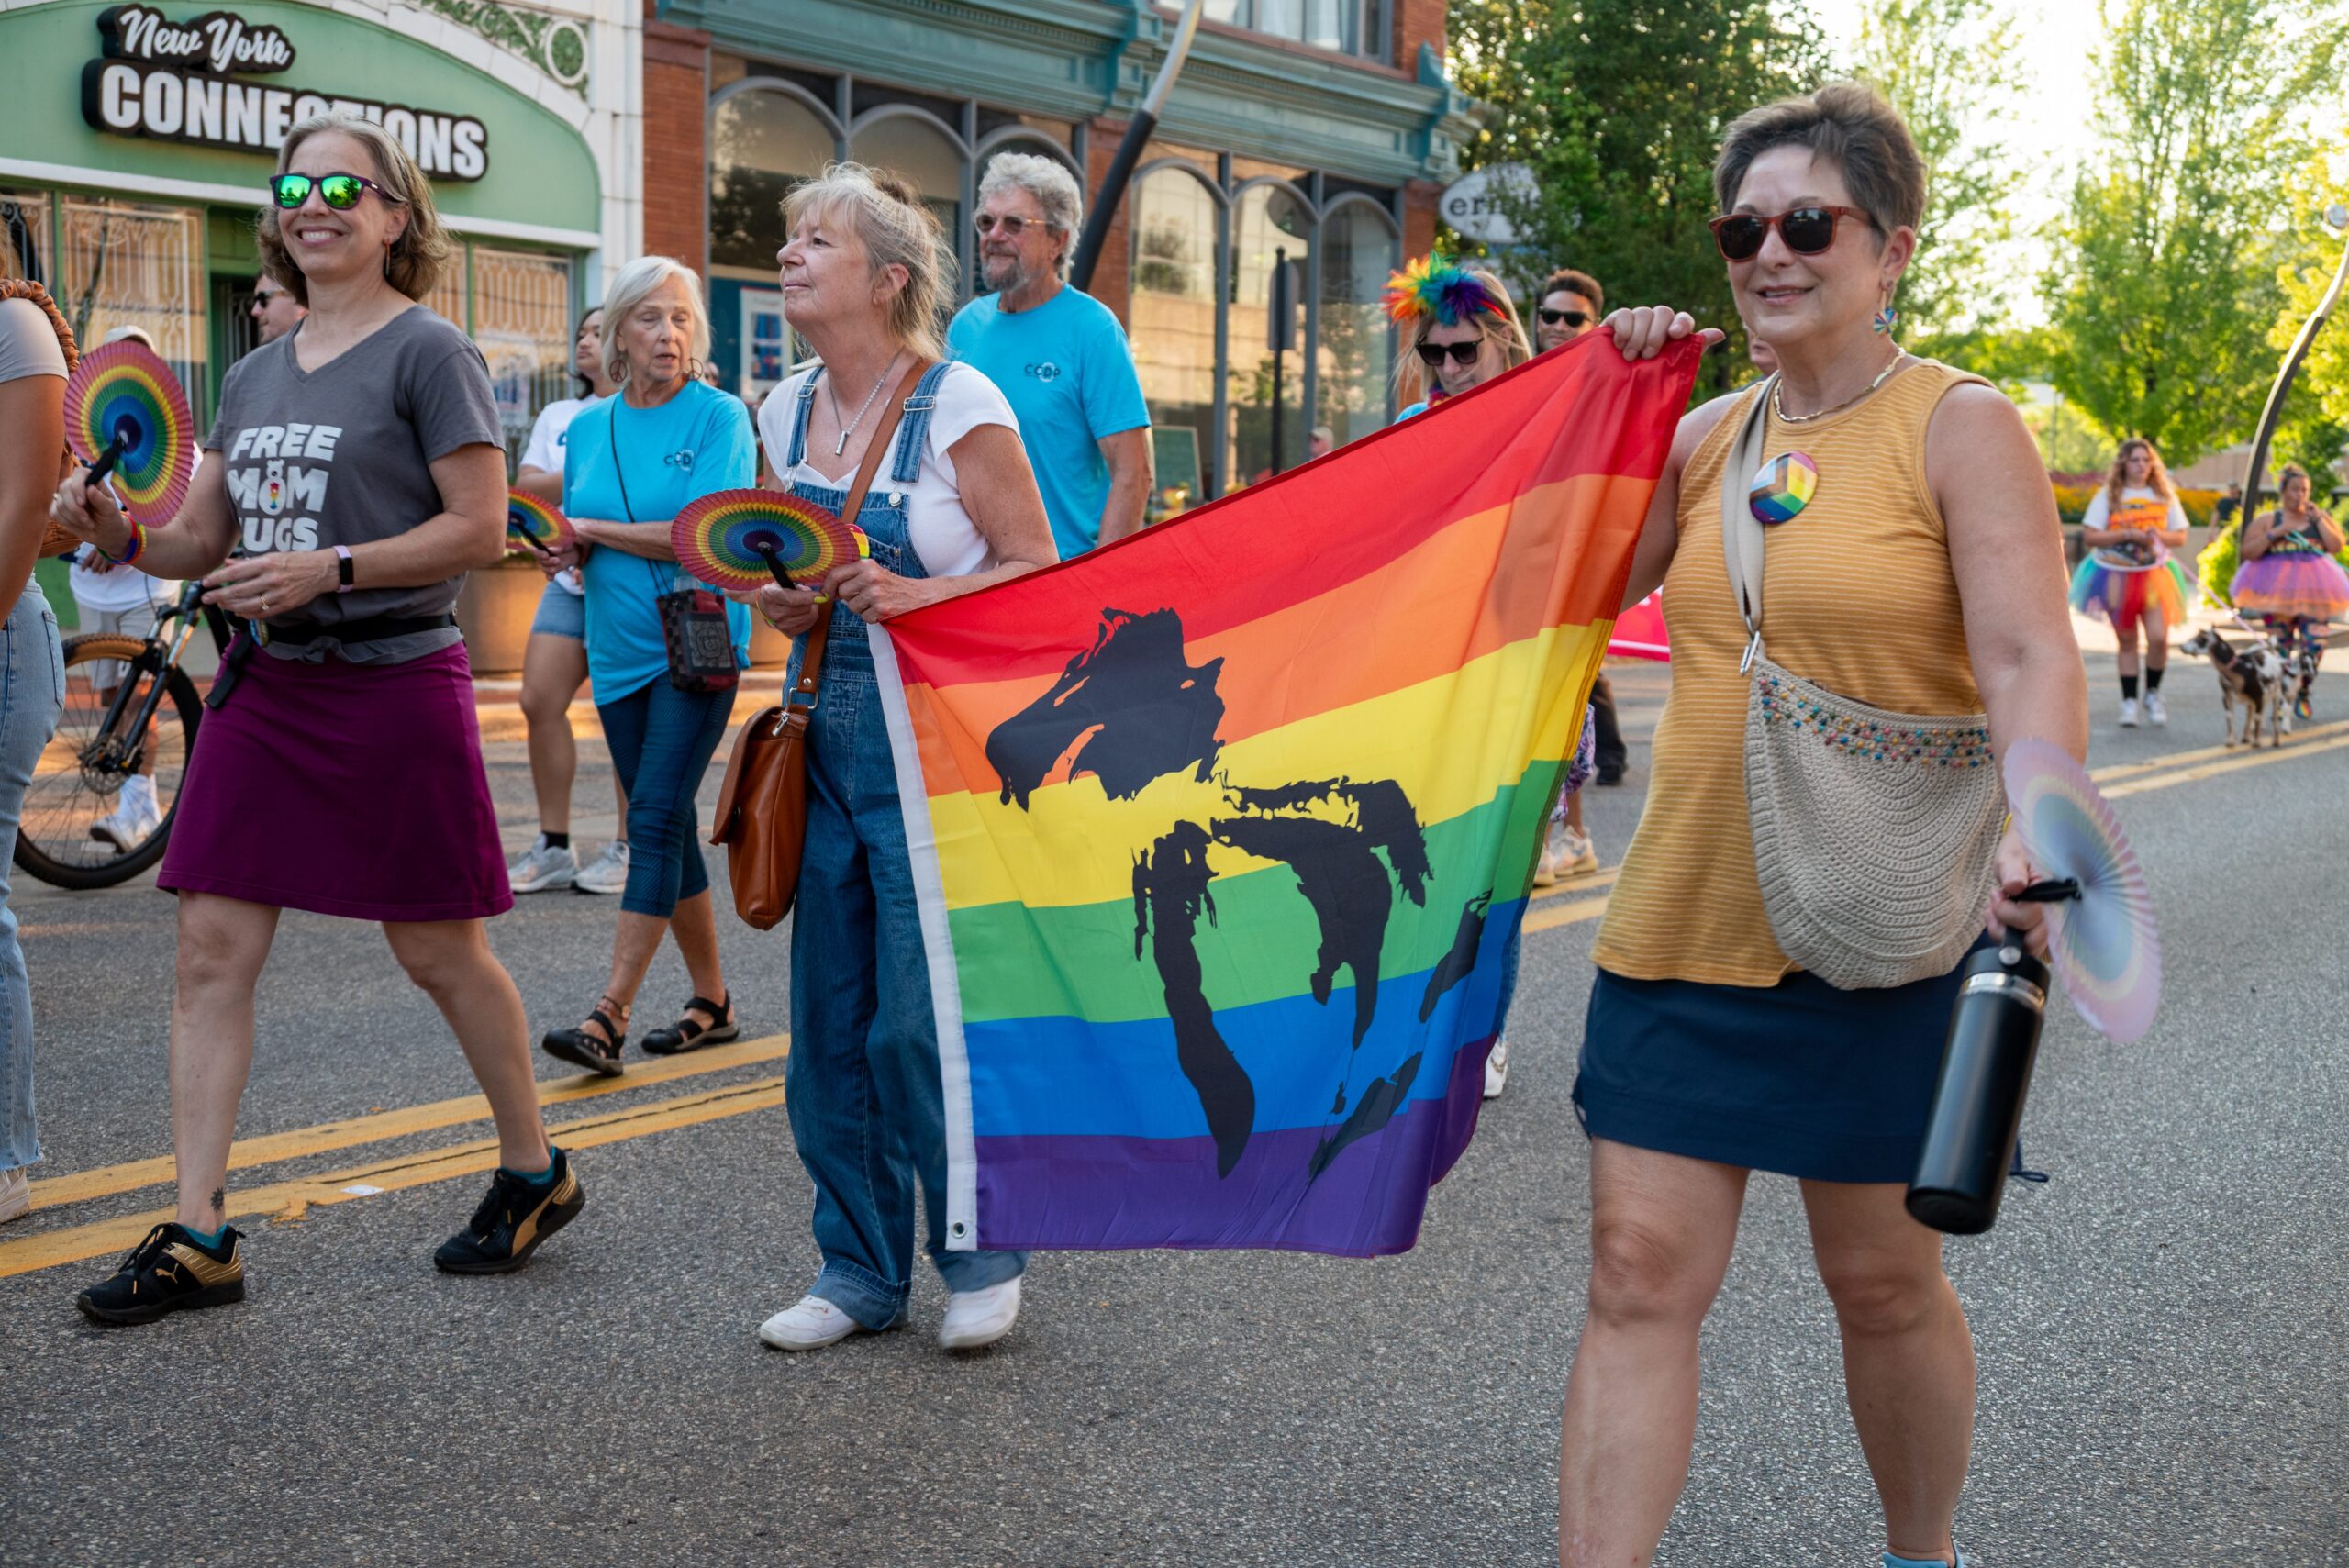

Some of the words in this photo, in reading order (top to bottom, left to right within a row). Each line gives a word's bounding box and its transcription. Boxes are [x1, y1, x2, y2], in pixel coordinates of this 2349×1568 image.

[119, 9, 204, 59] New
[205, 17, 292, 72] York
[102, 64, 486, 179] CONNEONS
[229, 422, 343, 462] FREE
[663, 451, 693, 466] CCD
[227, 459, 329, 516] MOM
[238, 517, 319, 552] UGS
